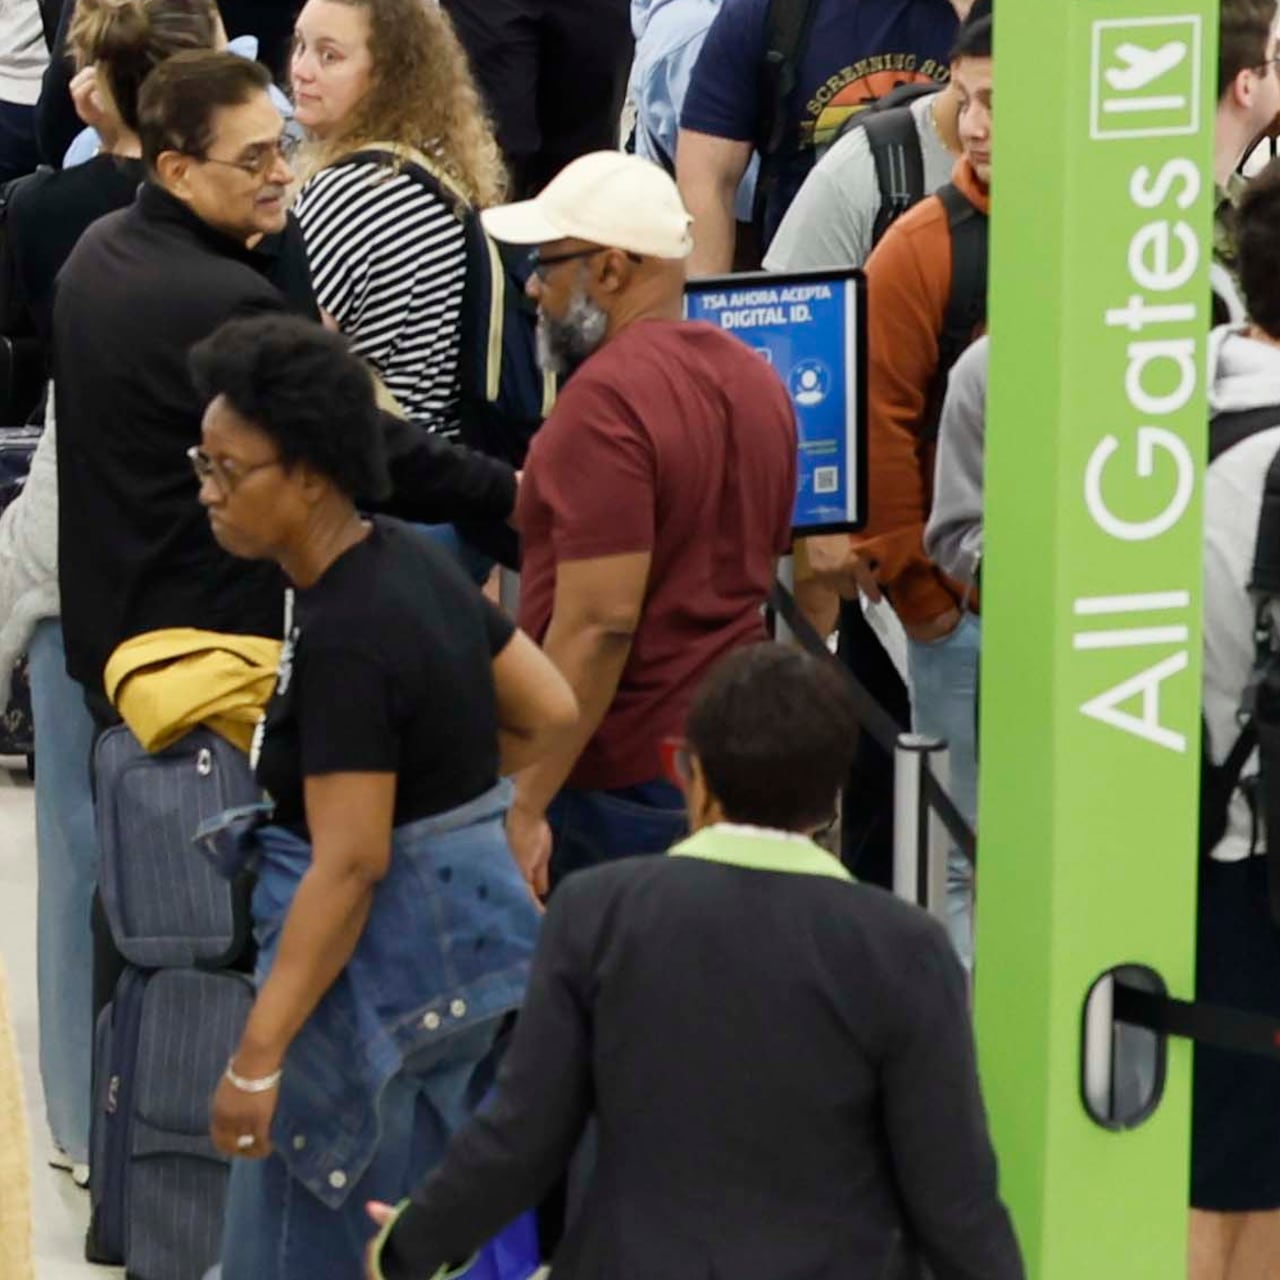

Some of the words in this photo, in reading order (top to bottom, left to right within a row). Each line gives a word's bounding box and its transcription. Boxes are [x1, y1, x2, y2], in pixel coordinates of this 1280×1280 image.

[806, 53, 917, 116] SCREENING
[701, 293, 728, 309] TSA
[730, 289, 779, 307] AHORA
[781, 285, 832, 302] ACEPTA
[720, 307, 788, 330] DIGITAL
[790, 304, 813, 322] ID.
[1085, 158, 1200, 540] Gates
[1074, 591, 1189, 751] All
